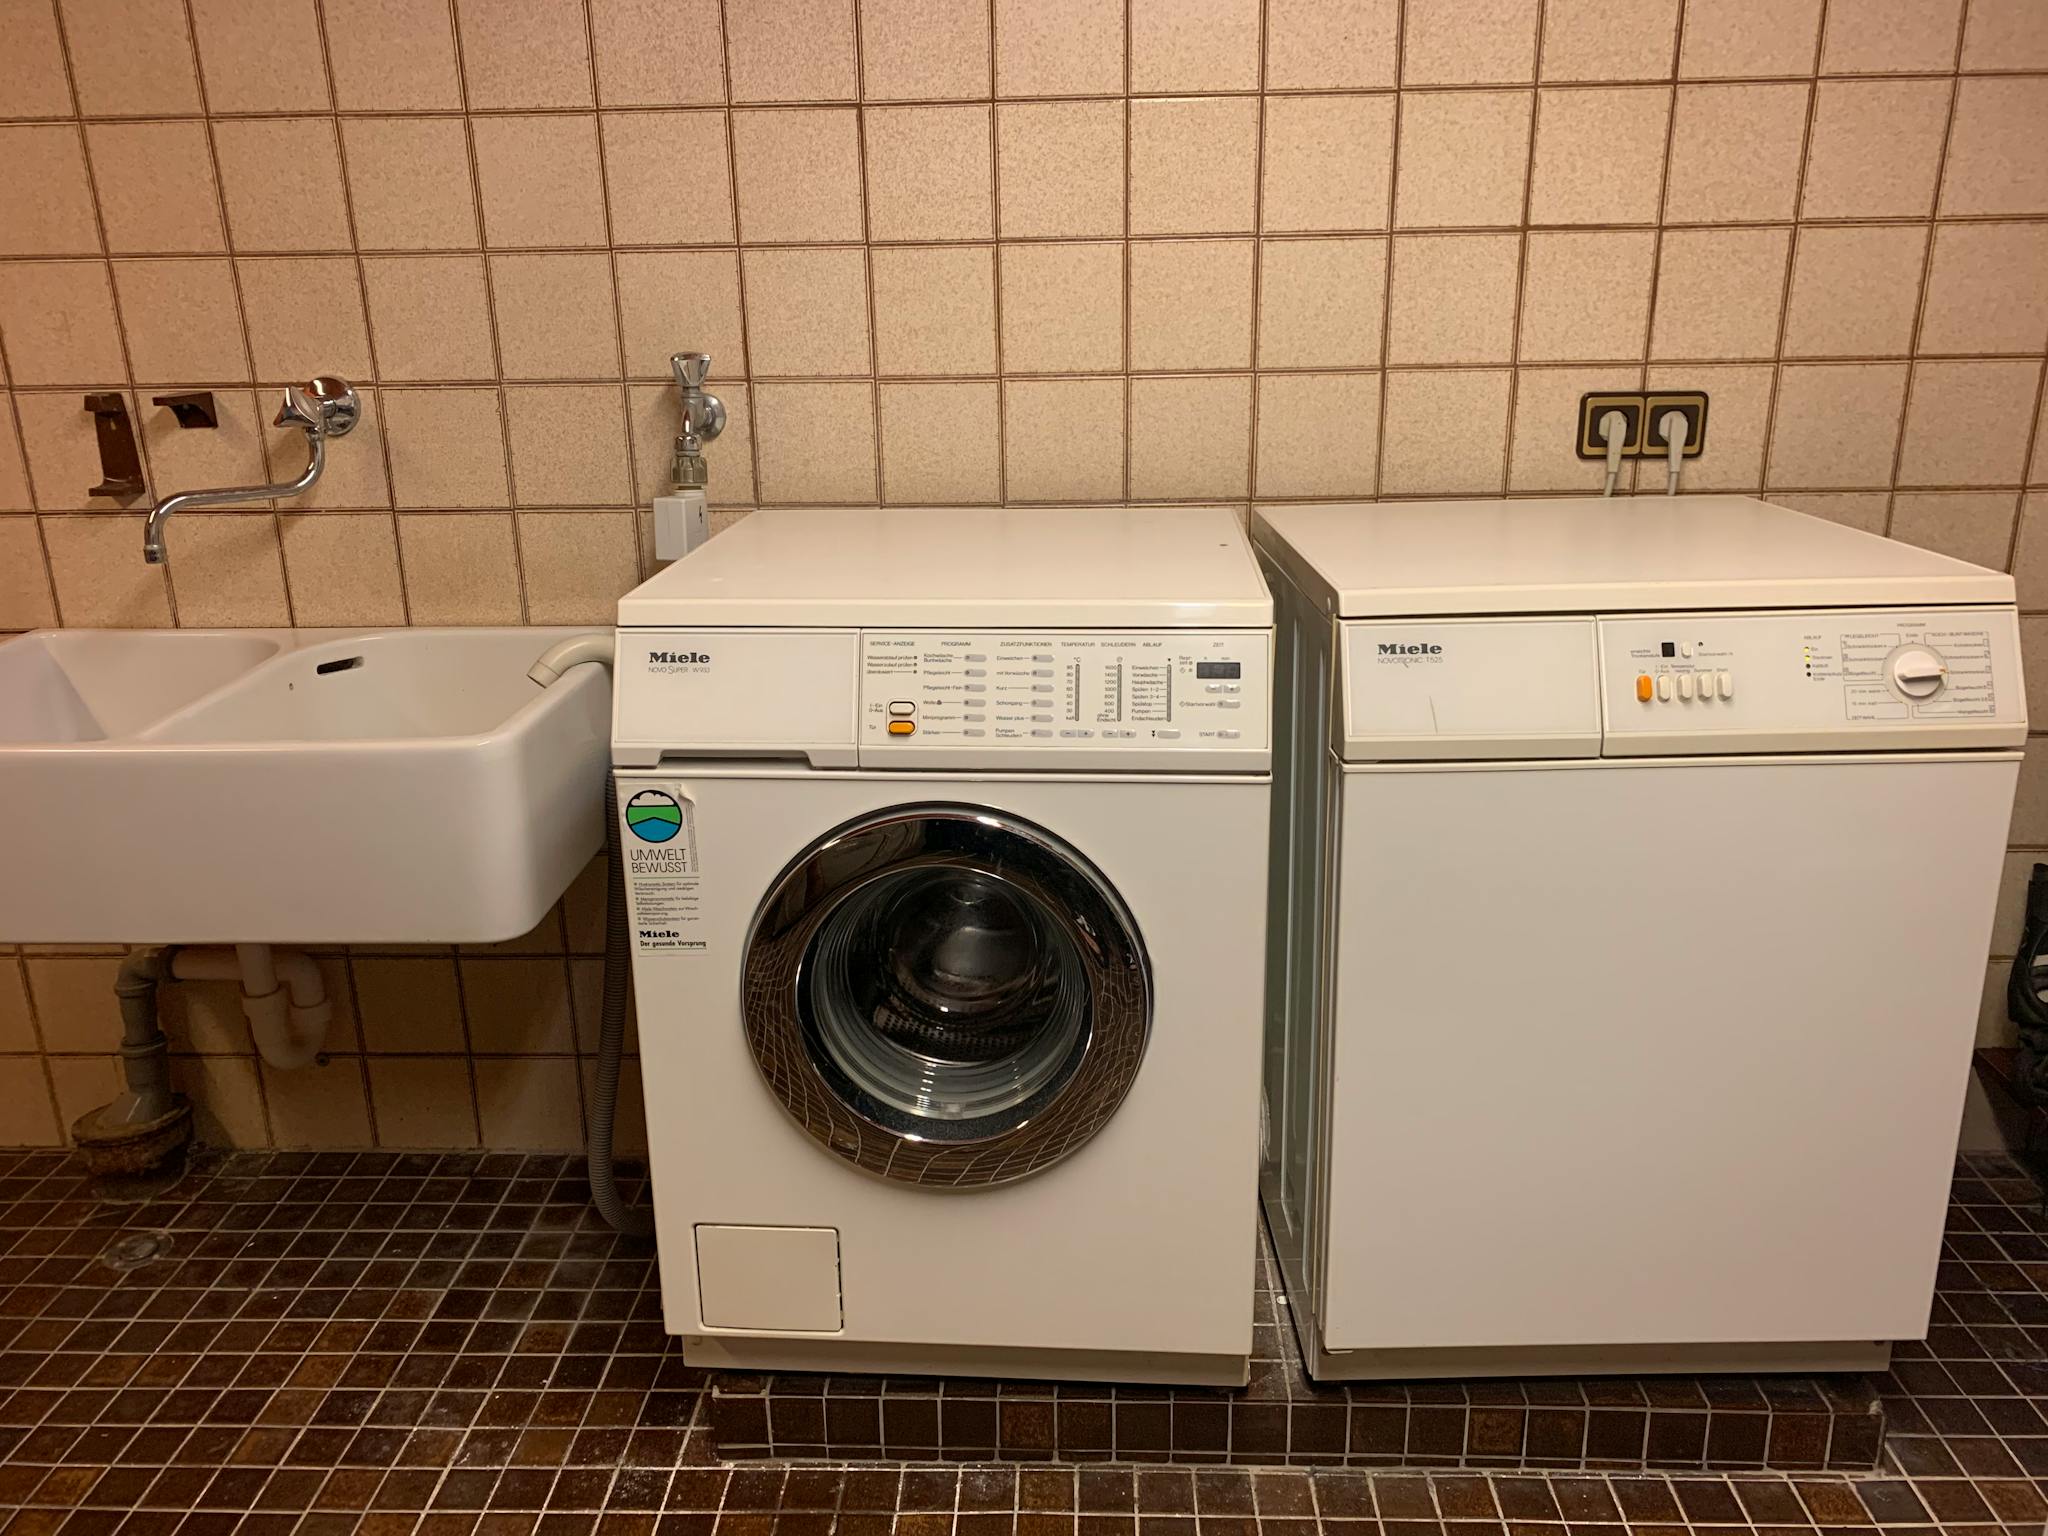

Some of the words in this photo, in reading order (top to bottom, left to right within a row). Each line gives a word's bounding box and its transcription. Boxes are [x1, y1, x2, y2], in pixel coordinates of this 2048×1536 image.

[1377, 643, 1443, 655] Miele
[649, 652, 711, 664] Miele
[630, 849, 687, 861] UMWELT
[631, 861, 687, 873] BEWUSST
[639, 930, 680, 938] Miele
[652, 940, 676, 948] gesunde
[677, 940, 707, 948] Vorsprung
